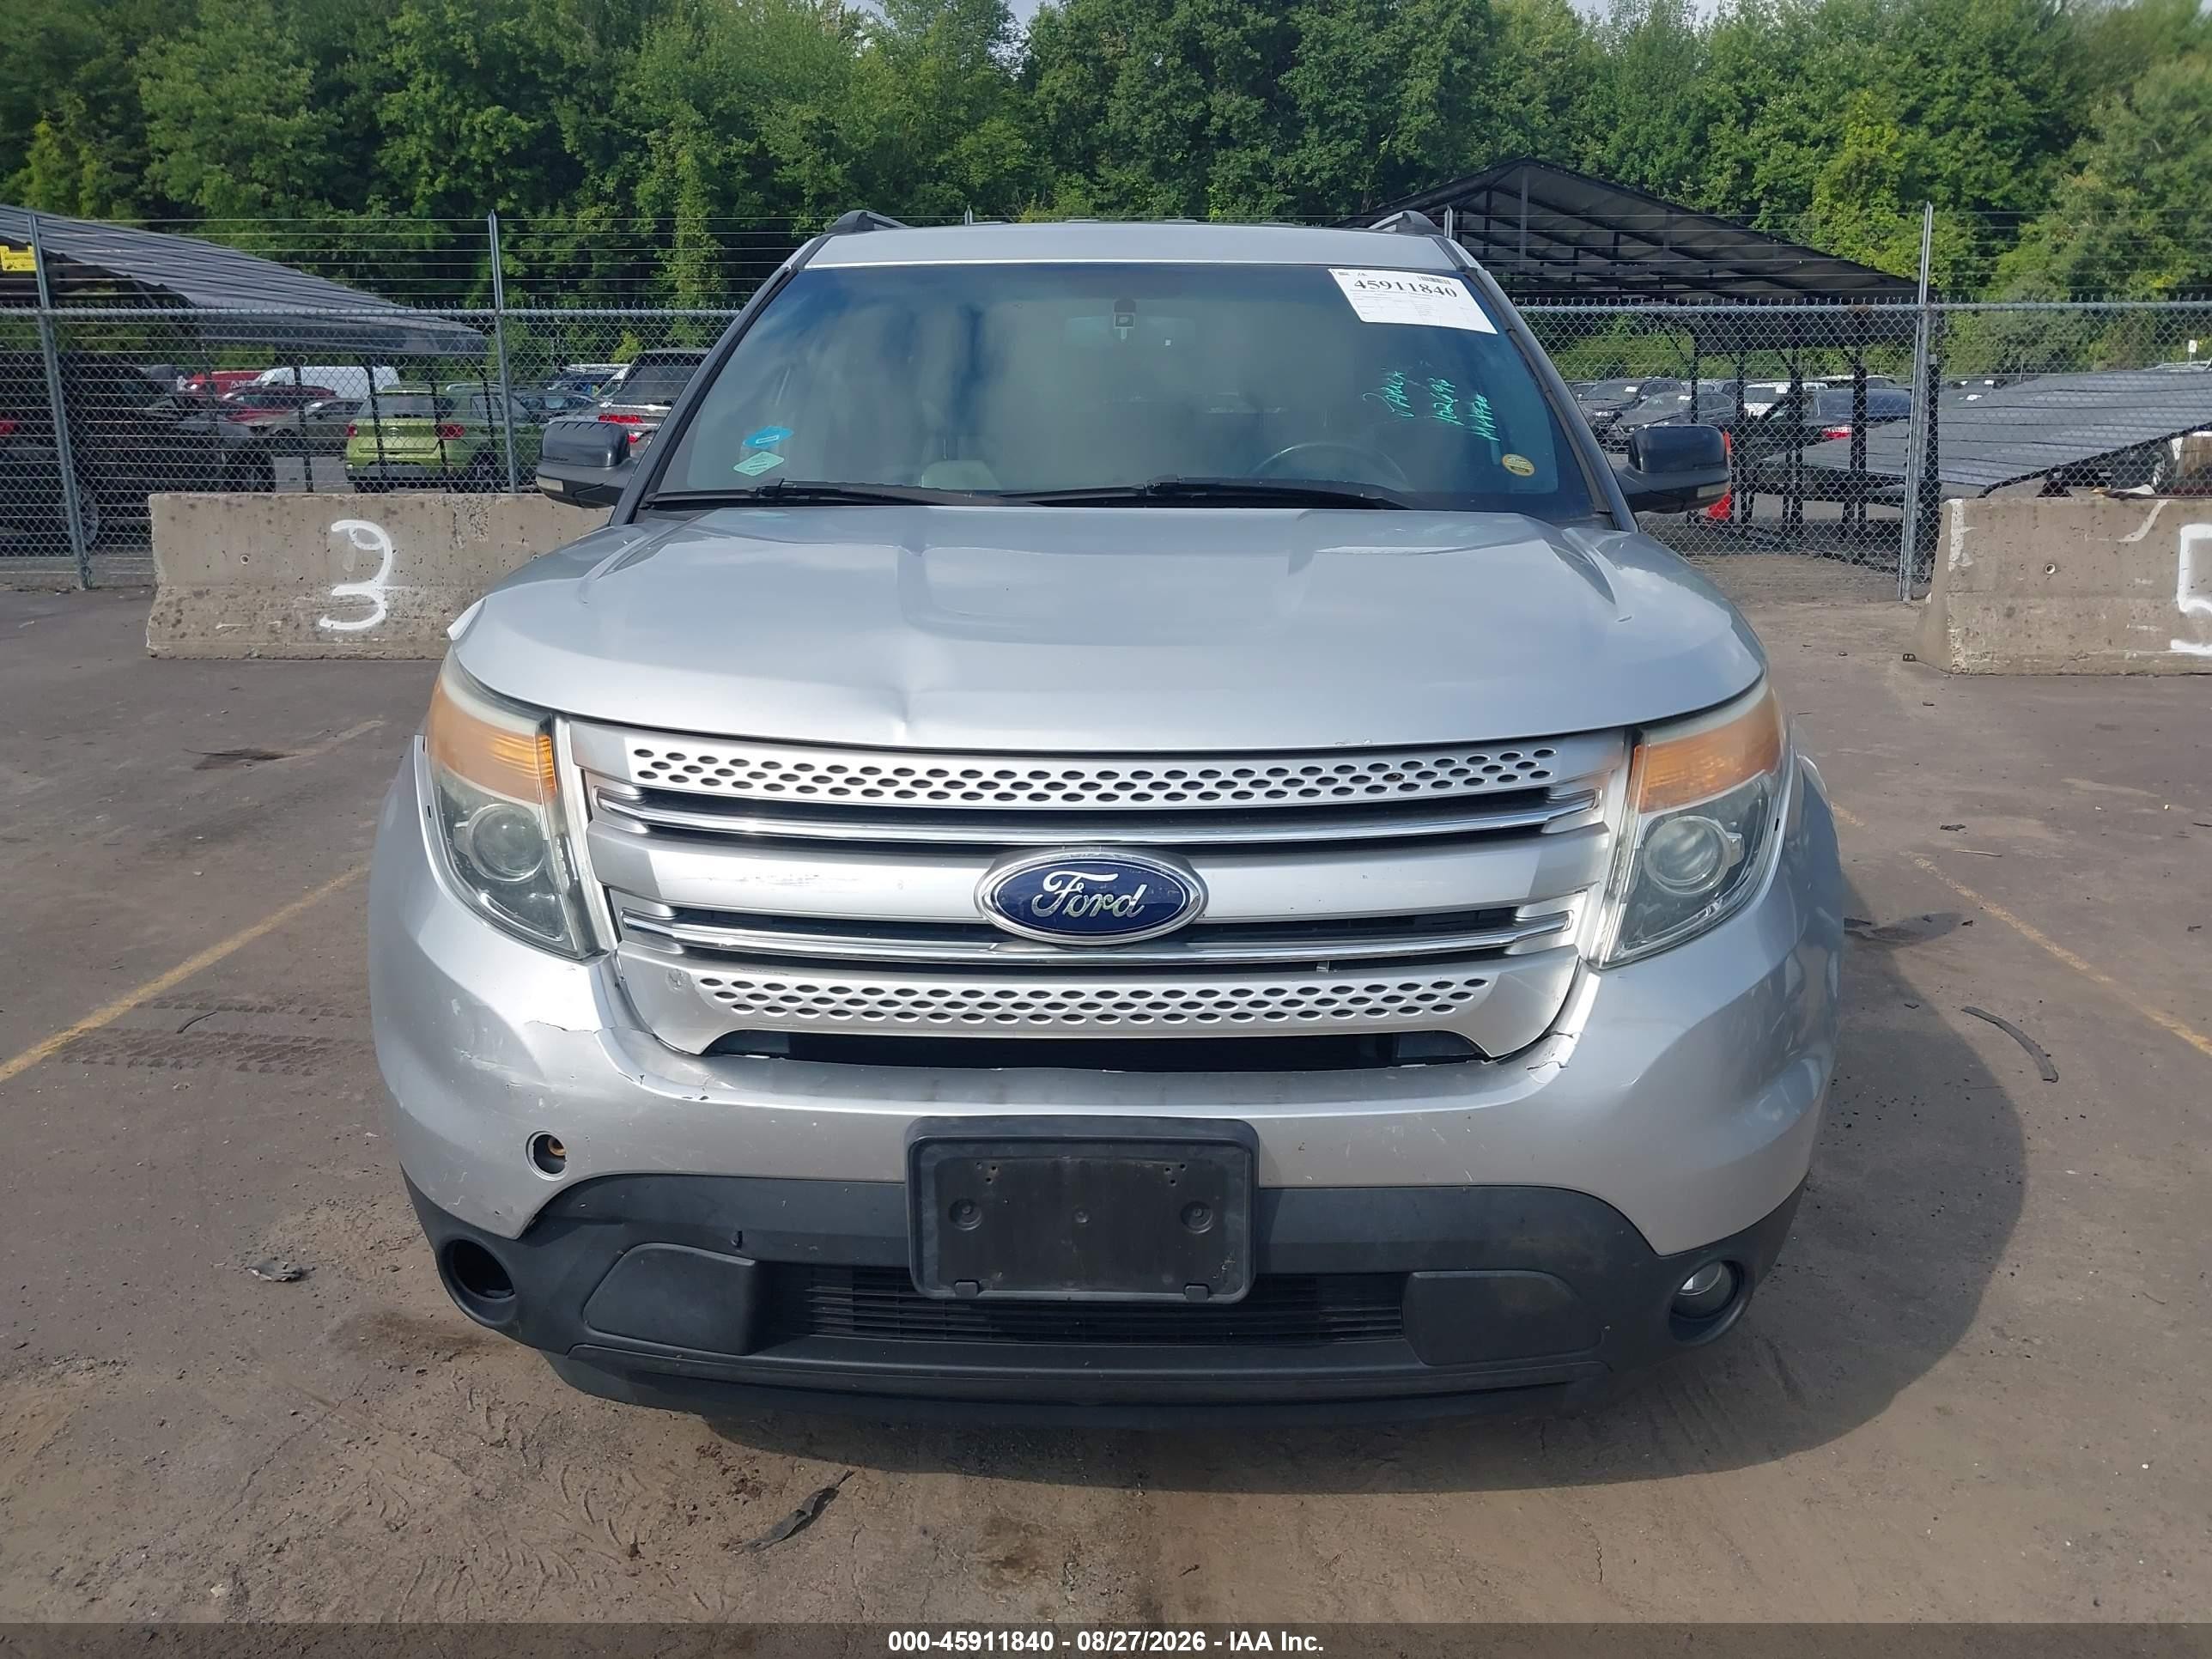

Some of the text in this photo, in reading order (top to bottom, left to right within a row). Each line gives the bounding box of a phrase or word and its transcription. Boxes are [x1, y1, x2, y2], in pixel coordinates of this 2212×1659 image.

[1353, 278, 1458, 299] 45911840
[319, 519, 393, 631] 3
[1031, 870, 1148, 918] Ford
